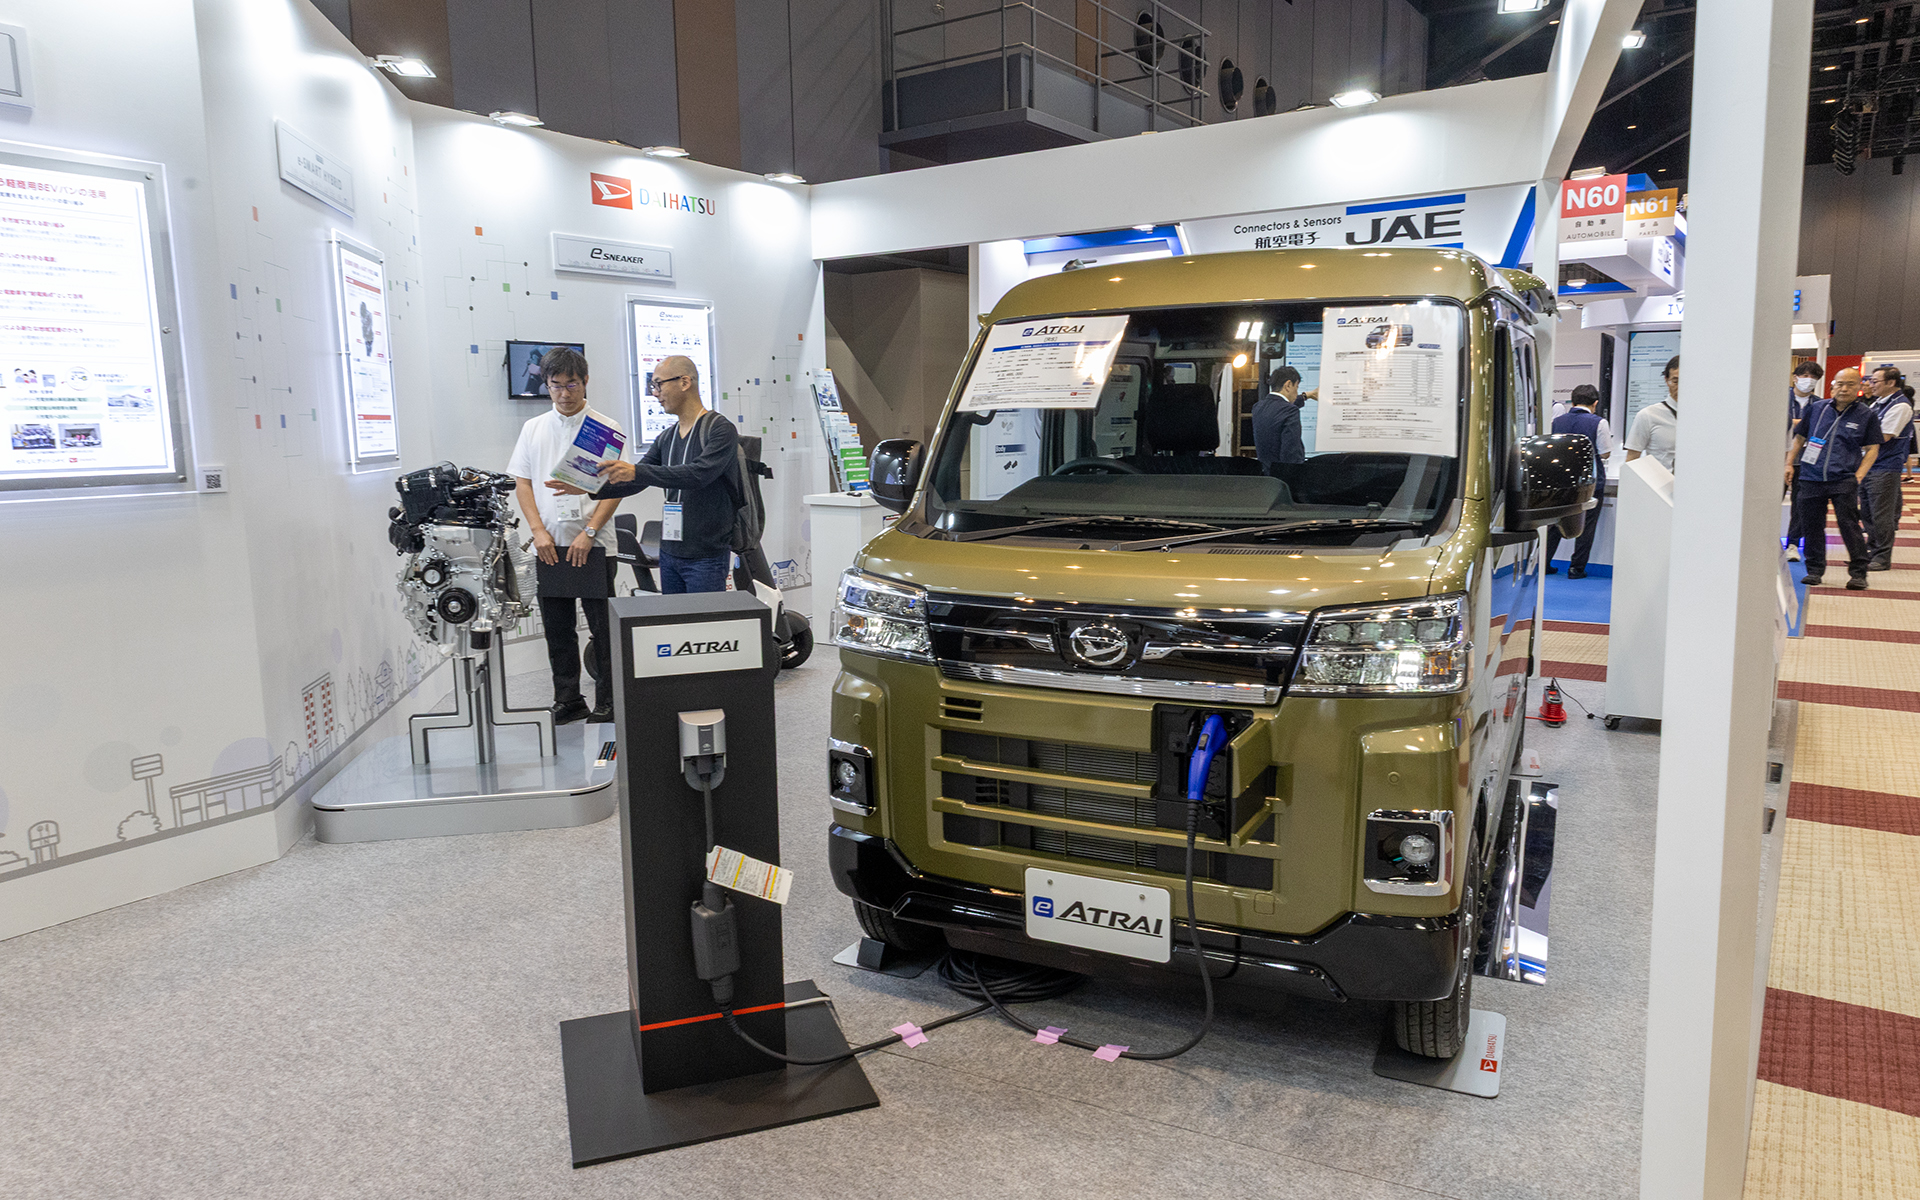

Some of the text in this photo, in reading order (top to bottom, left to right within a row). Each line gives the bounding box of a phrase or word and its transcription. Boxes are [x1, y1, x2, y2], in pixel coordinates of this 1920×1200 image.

[639, 188, 716, 216] DAIHATSU
[1566, 184, 1620, 210] N60
[1630, 196, 1669, 215] N61
[1234, 216, 1342, 234] Connectors & Sensors
[1345, 209, 1465, 245] JAE
[1255, 231, 1320, 249] 航空電子
[1566, 230, 1615, 239] AUTOMOBILE
[602, 252, 643, 264] SNEAKER
[1032, 325, 1085, 336] ATRAI
[658, 640, 739, 656] e ATRAI
[1034, 899, 1163, 937] e ATRAI
